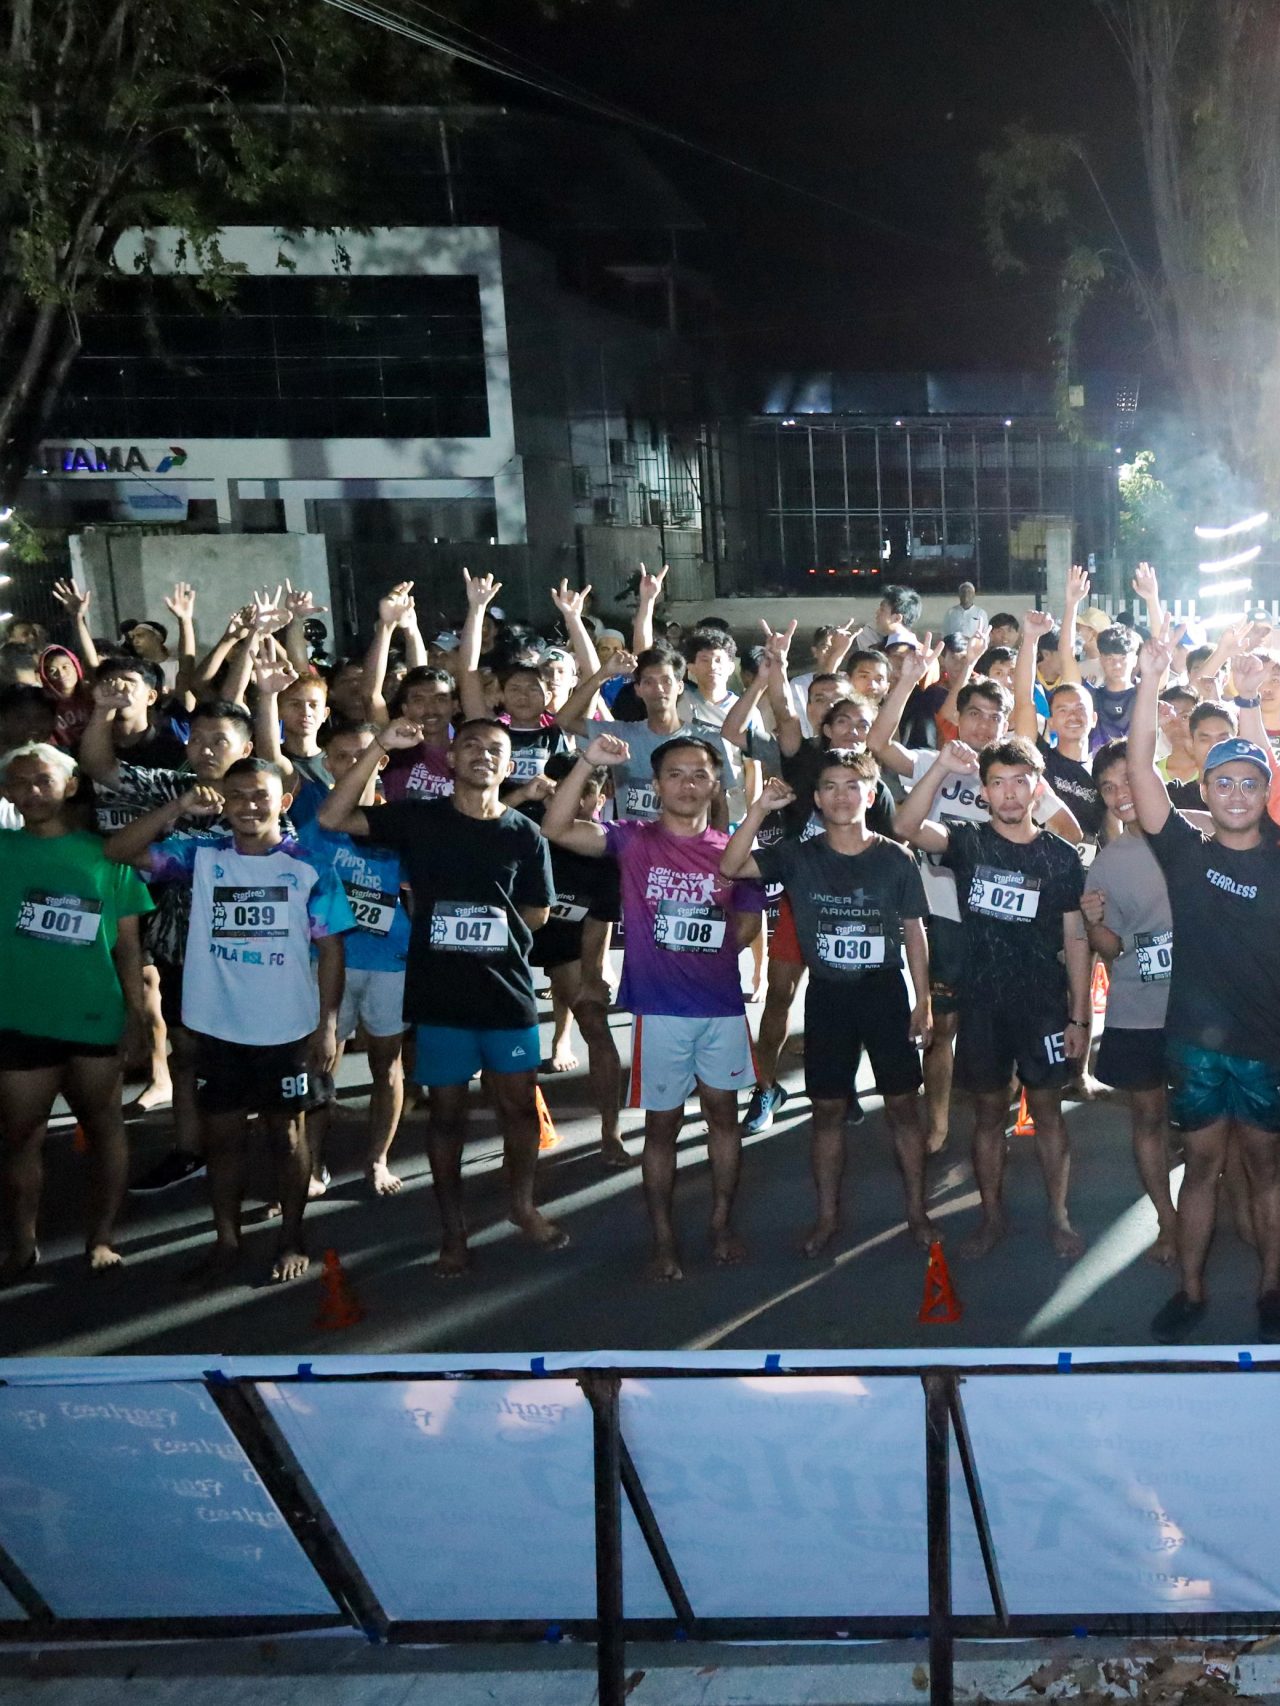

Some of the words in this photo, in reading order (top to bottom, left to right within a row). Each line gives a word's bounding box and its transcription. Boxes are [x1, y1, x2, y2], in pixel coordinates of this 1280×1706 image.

[647, 872, 700, 891] RELAY
[1206, 868, 1258, 899] FEARLESS
[645, 884, 699, 903] RUN
[973, 883, 983, 893] 75
[809, 892, 852, 904] UNDER
[971, 894, 981, 904] M
[990, 887, 1025, 911] 021
[22, 907, 33, 917] 75
[213, 906, 224, 916] 75
[234, 905, 275, 926] 039
[821, 907, 880, 917] ARMOUR
[41, 909, 83, 934] 001
[213, 917, 224, 927] M
[433, 921, 445, 931] 75
[656, 919, 667, 929] 75
[433, 931, 444, 942] M
[455, 921, 492, 941] 047
[655, 930, 665, 940] M
[674, 921, 712, 943] 008
[818, 938, 828, 948] 75
[834, 939, 871, 959] 030
[269, 952, 285, 966] FC
[1138, 953, 1149, 962] 50
[1140, 963, 1150, 972] M
[1044, 1031, 1065, 1065] 15
[281, 1073, 309, 1099] 98
